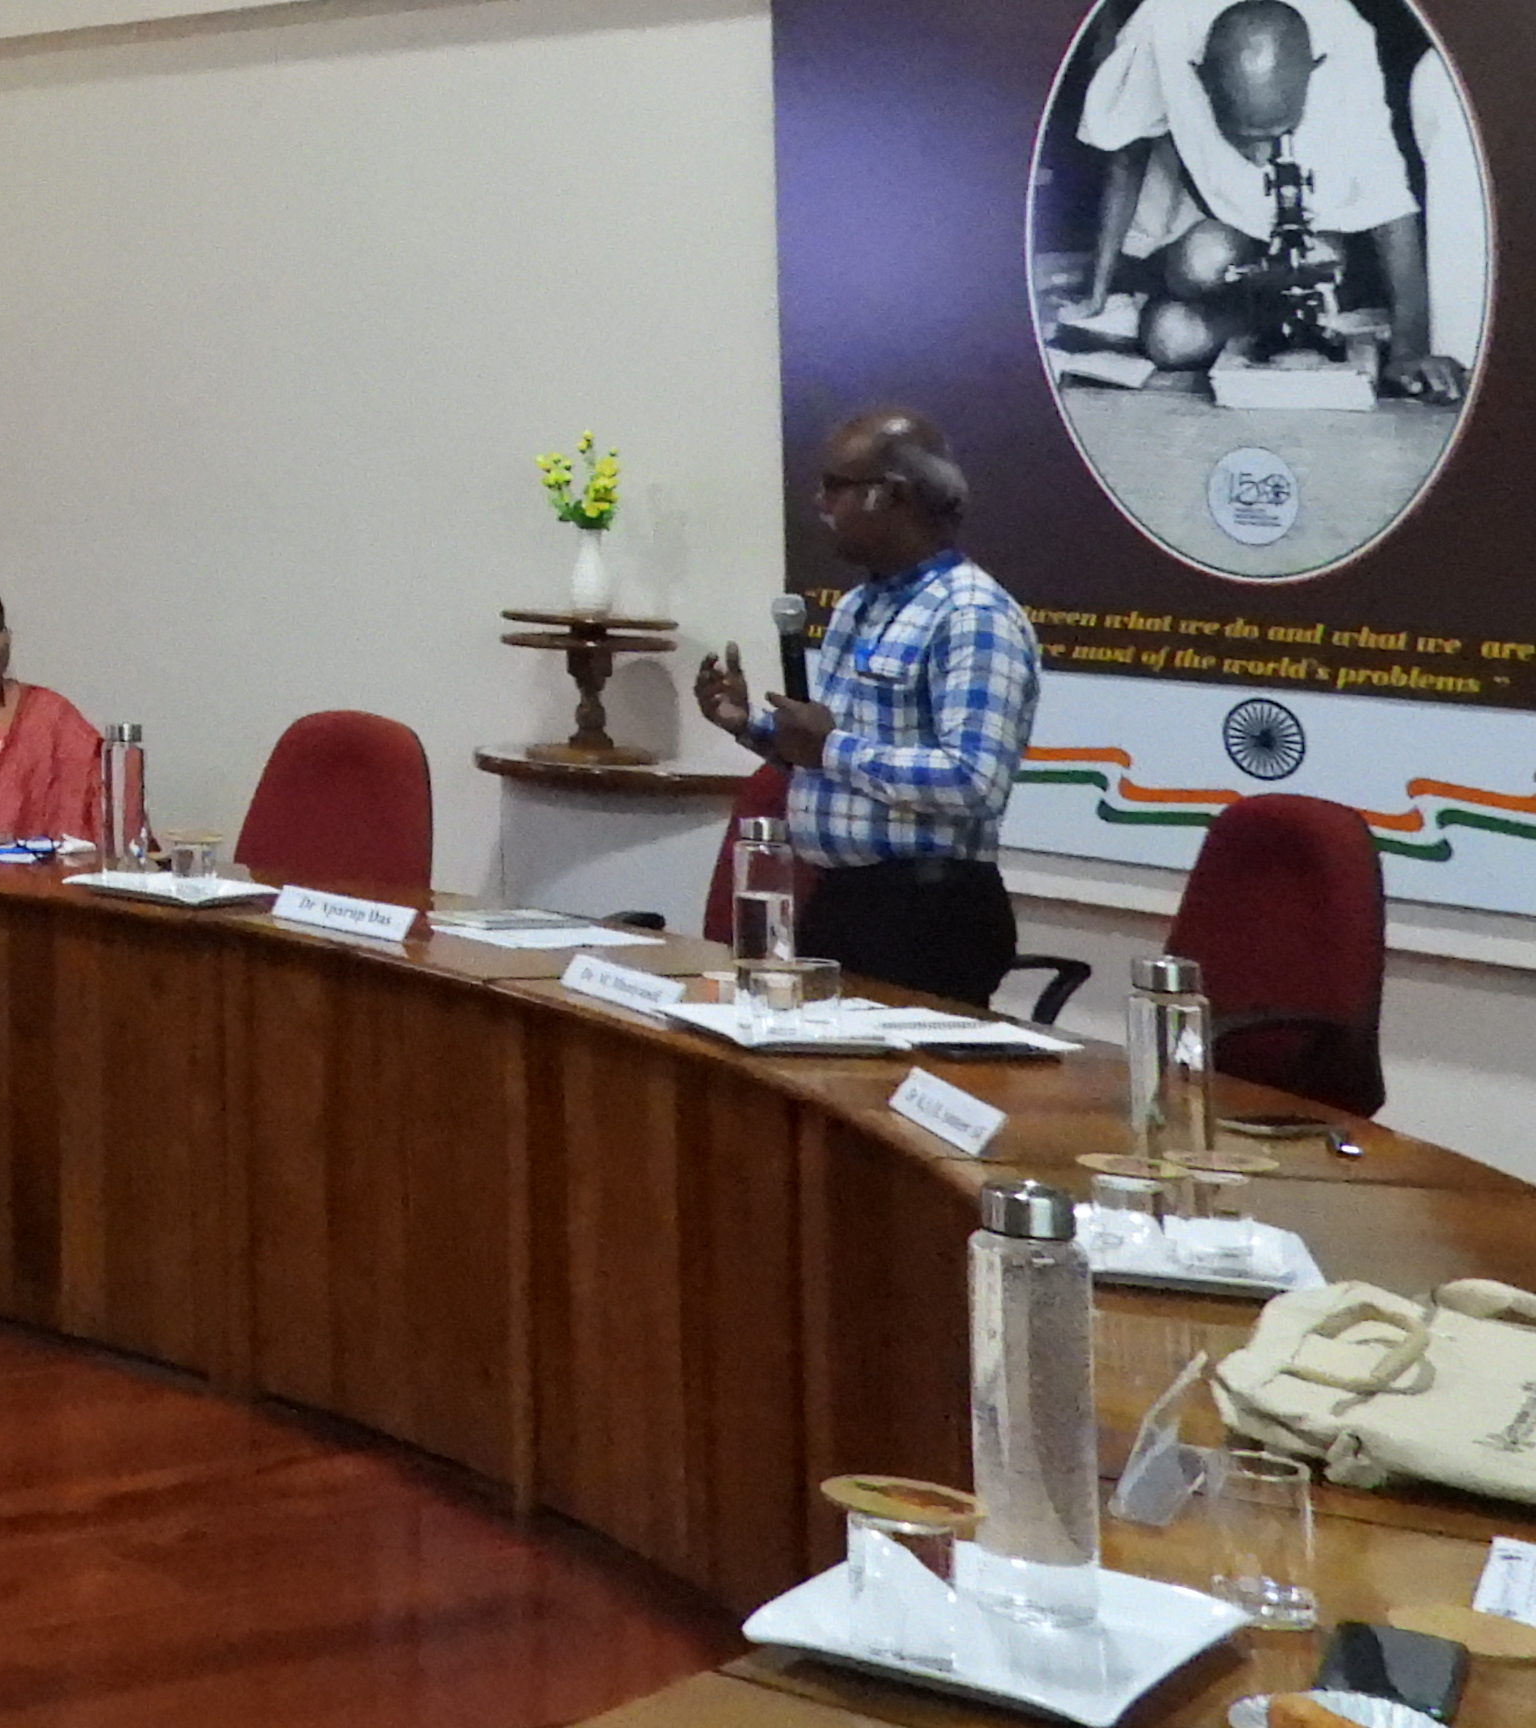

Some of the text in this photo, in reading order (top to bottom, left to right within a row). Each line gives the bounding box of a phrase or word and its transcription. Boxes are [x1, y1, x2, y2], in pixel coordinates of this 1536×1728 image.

[1024, 605, 1097, 627] ween
[1103, 611, 1173, 632] what
[1178, 619, 1221, 635] we
[1224, 617, 1259, 638] do
[1267, 623, 1326, 645] and
[1331, 625, 1409, 651] what
[1416, 636, 1462, 654] we
[1481, 640, 1535, 662] are
[1071, 646, 1137, 664] most
[1140, 645, 1171, 672] of
[1173, 648, 1217, 670] the
[1336, 664, 1481, 694] problems
